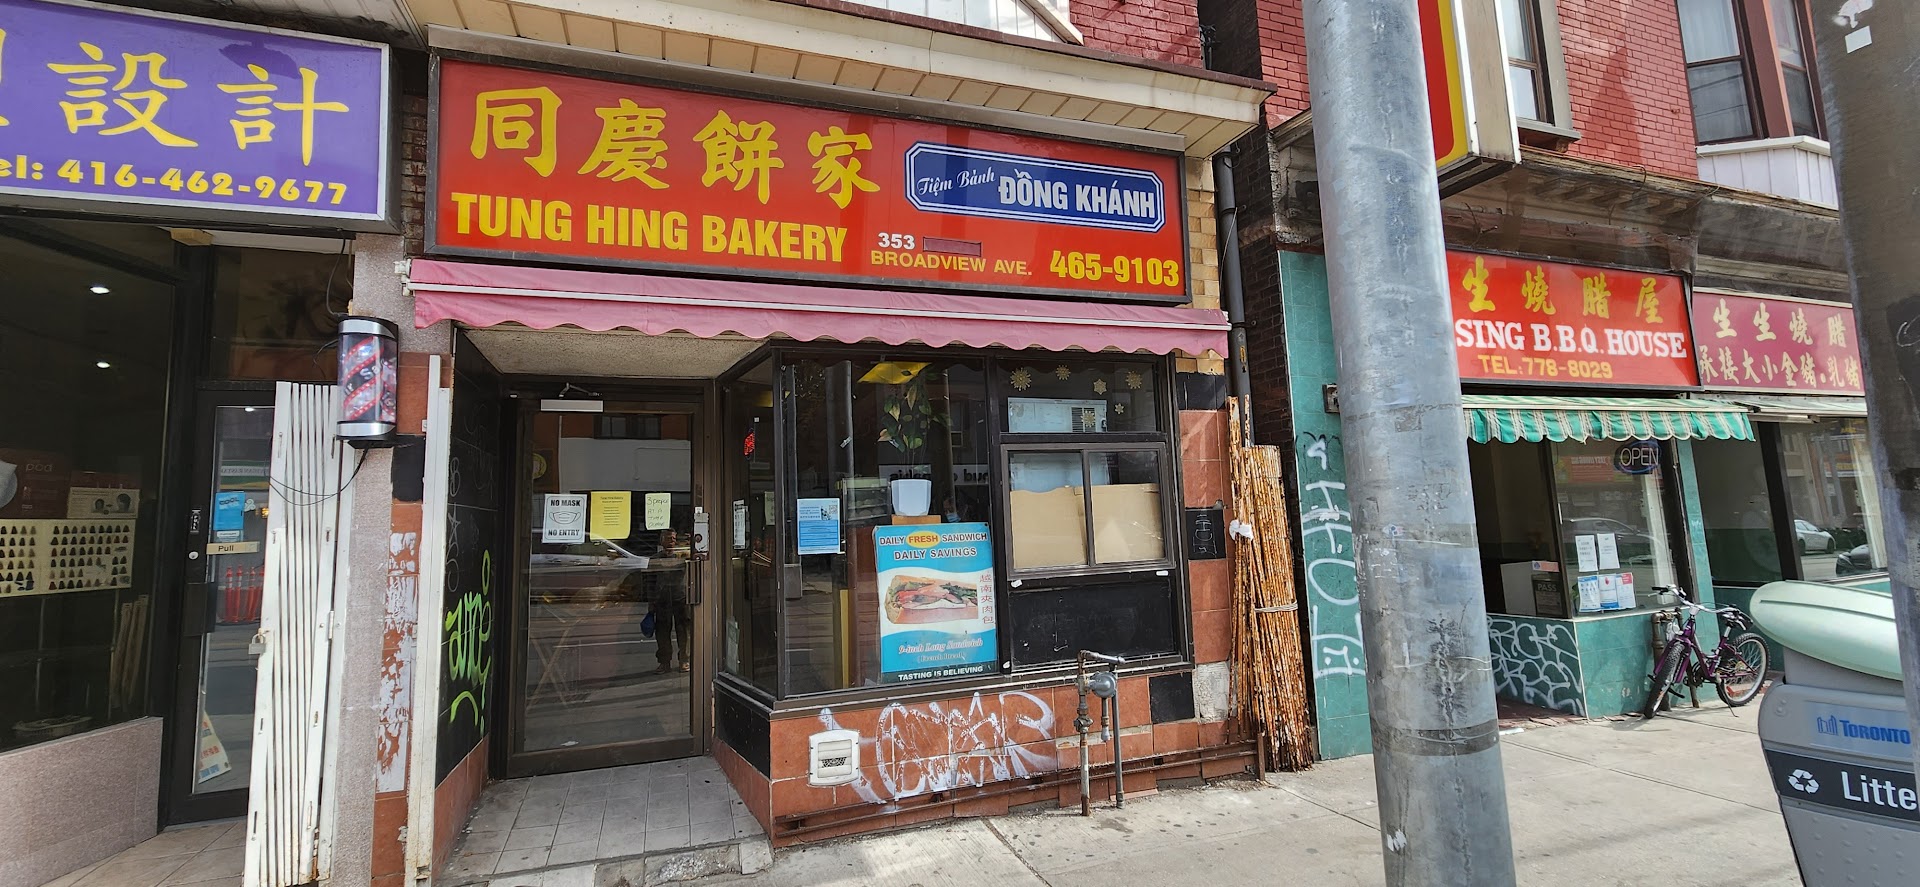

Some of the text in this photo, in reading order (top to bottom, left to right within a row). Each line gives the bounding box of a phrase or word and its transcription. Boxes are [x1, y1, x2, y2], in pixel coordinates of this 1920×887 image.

[0, 27, 350, 167] 設計
[470, 86, 881, 210] 同慶餅家
[0, 154, 347, 205] el: 416-462-9677
[998, 168, 1155, 219] ĐỒNG KHÁNH
[451, 192, 848, 263] TUNG HING BAKERY
[877, 232, 916, 250] 353
[871, 250, 1033, 276] BROADVIEW AVE.
[1050, 250, 1179, 288] 465-9103
[1454, 319, 1525, 351] SING
[1620, 447, 1659, 467] OPEN
[879, 533, 988, 546] DAILY FRESH SANDWICH
[894, 547, 977, 560] DAILY SAVINGS
[898, 672, 932, 681] TASTING
[943, 665, 984, 676] BELIEVING
[1839, 719, 1912, 745] TORONTO
[1841, 771, 1917, 811] Litte
